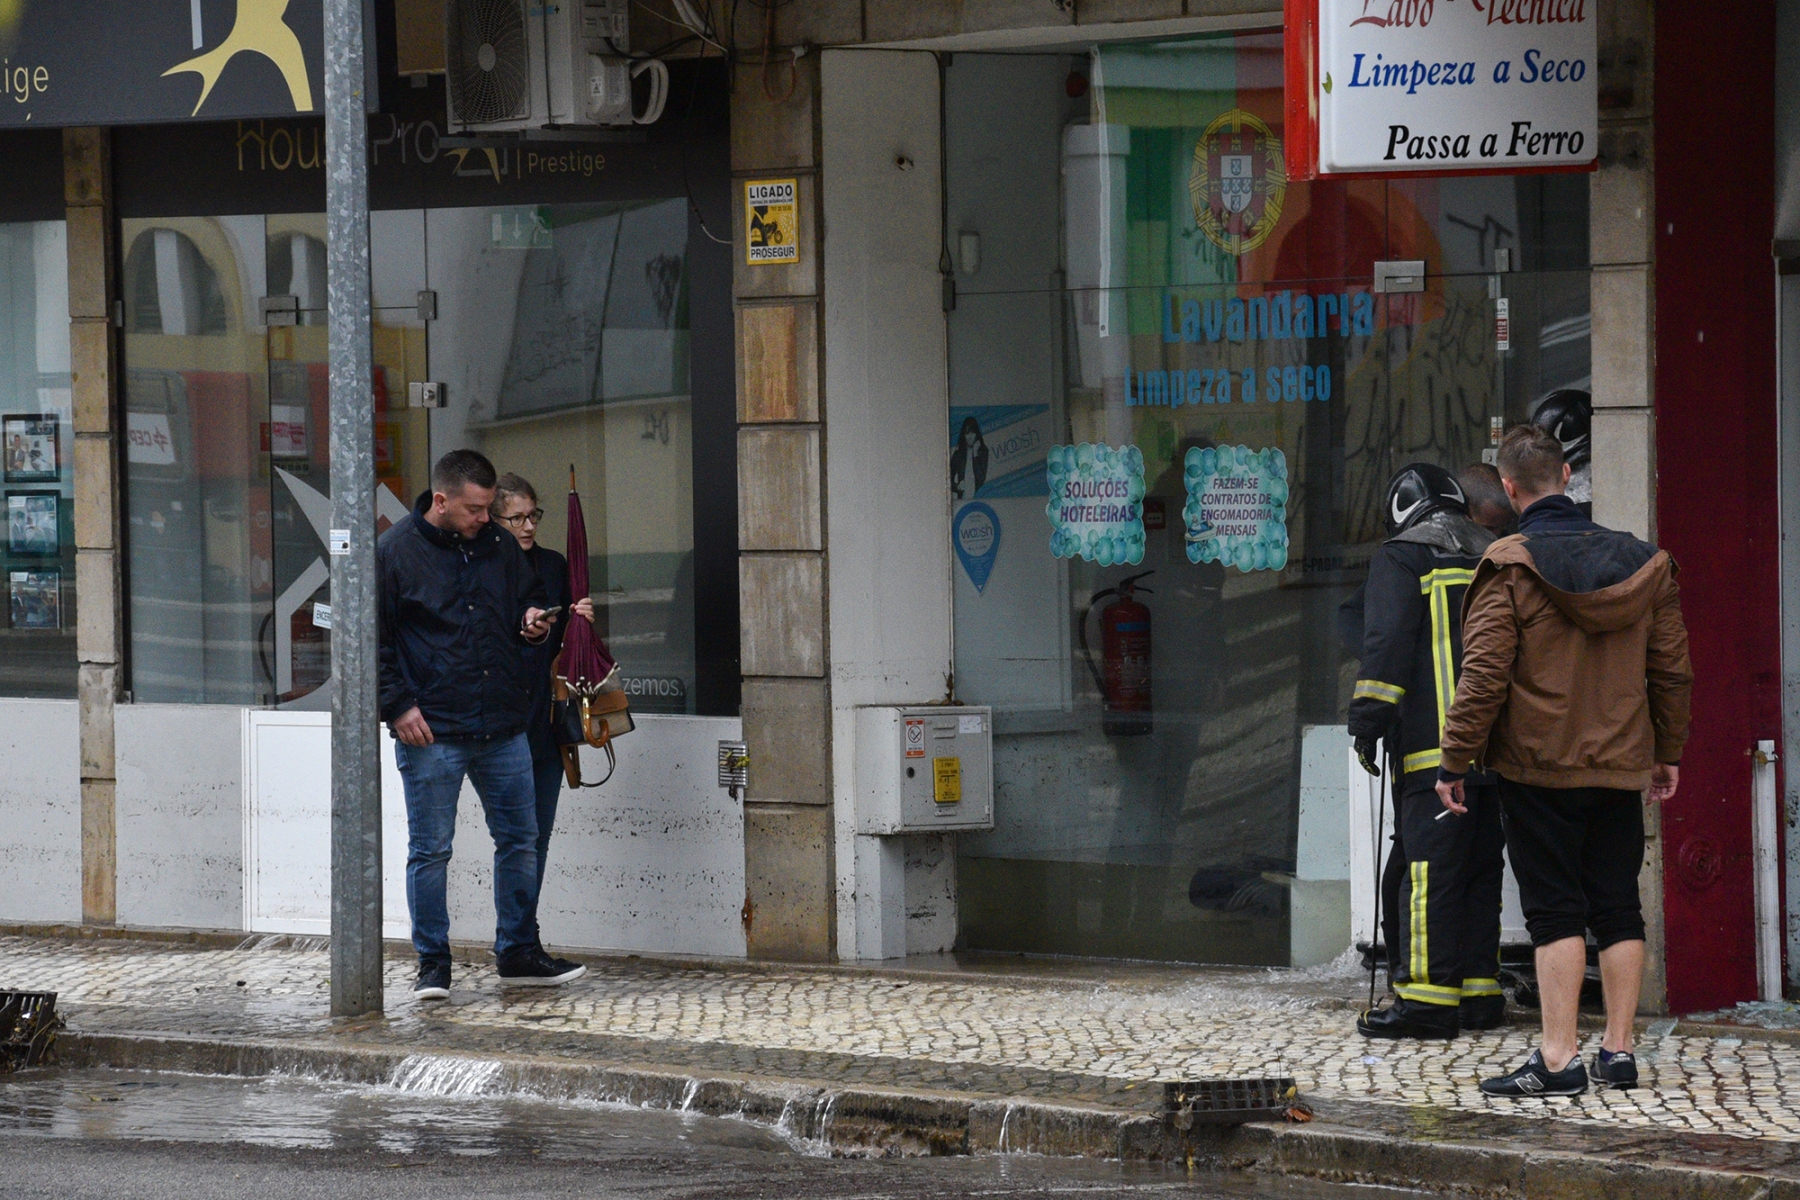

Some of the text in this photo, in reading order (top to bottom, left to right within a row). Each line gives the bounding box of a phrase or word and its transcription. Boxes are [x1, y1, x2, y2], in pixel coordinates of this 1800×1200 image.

[1348, 49, 1586, 94] Limpeza a Seco
[1383, 121, 1584, 160] Passa a Ferro
[529, 152, 606, 177] Prestige
[749, 185, 793, 199] LIGADO
[751, 246, 795, 259] PROSEGUR
[1163, 289, 1373, 343] Lavandaria
[1124, 364, 1331, 409] Limpeza a seco
[1065, 477, 1129, 502] SOLUÇÕES
[1213, 477, 1259, 489] FAZEM-SE
[1201, 493, 1272, 505] CONTRATOS DE
[1060, 504, 1135, 522] HOTELEIRAS
[1201, 508, 1272, 520] ENGOMADORIA
[1215, 524, 1257, 536] MENSAIS
